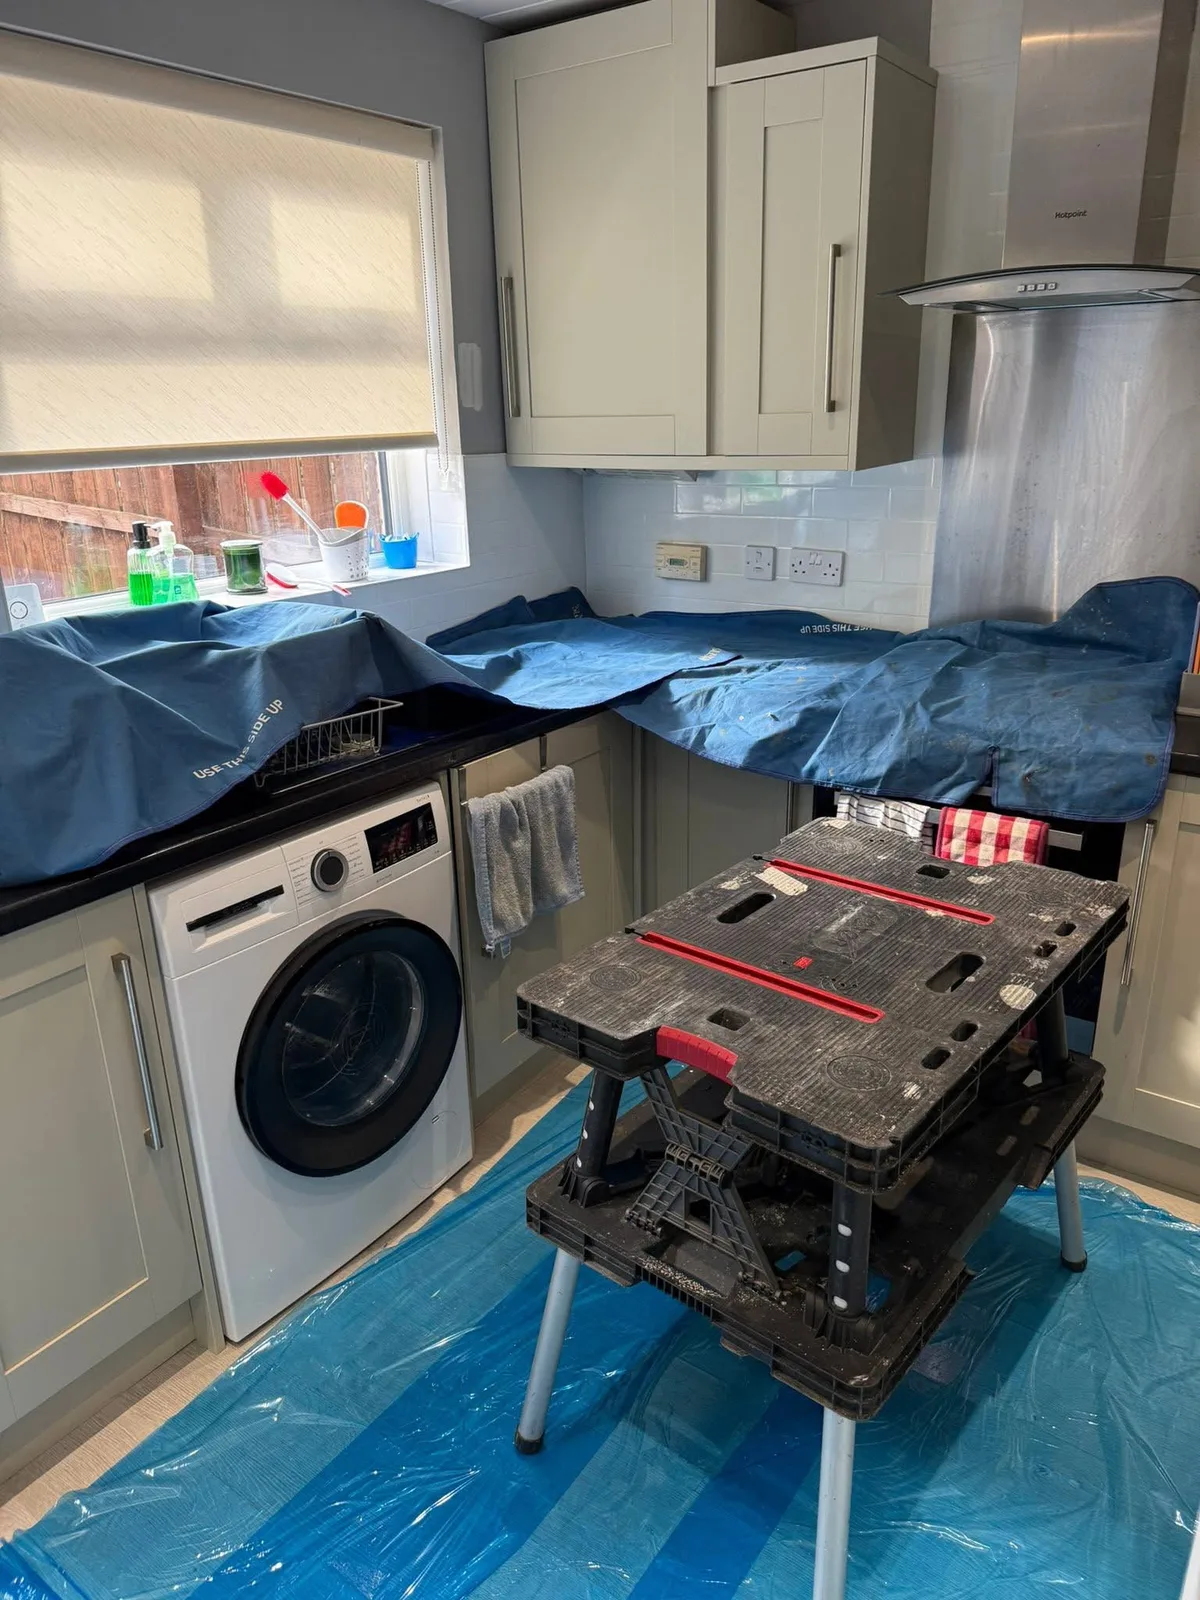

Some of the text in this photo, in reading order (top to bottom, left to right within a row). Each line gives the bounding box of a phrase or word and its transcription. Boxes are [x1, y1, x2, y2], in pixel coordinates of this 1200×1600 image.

[1054, 209, 1088, 219] Hotpoint
[800, 624, 811, 634] UP
[812, 624, 831, 634] SIDE
[832, 624, 852, 633] THIS
[193, 699, 284, 779] USE THIS SIDE UP
